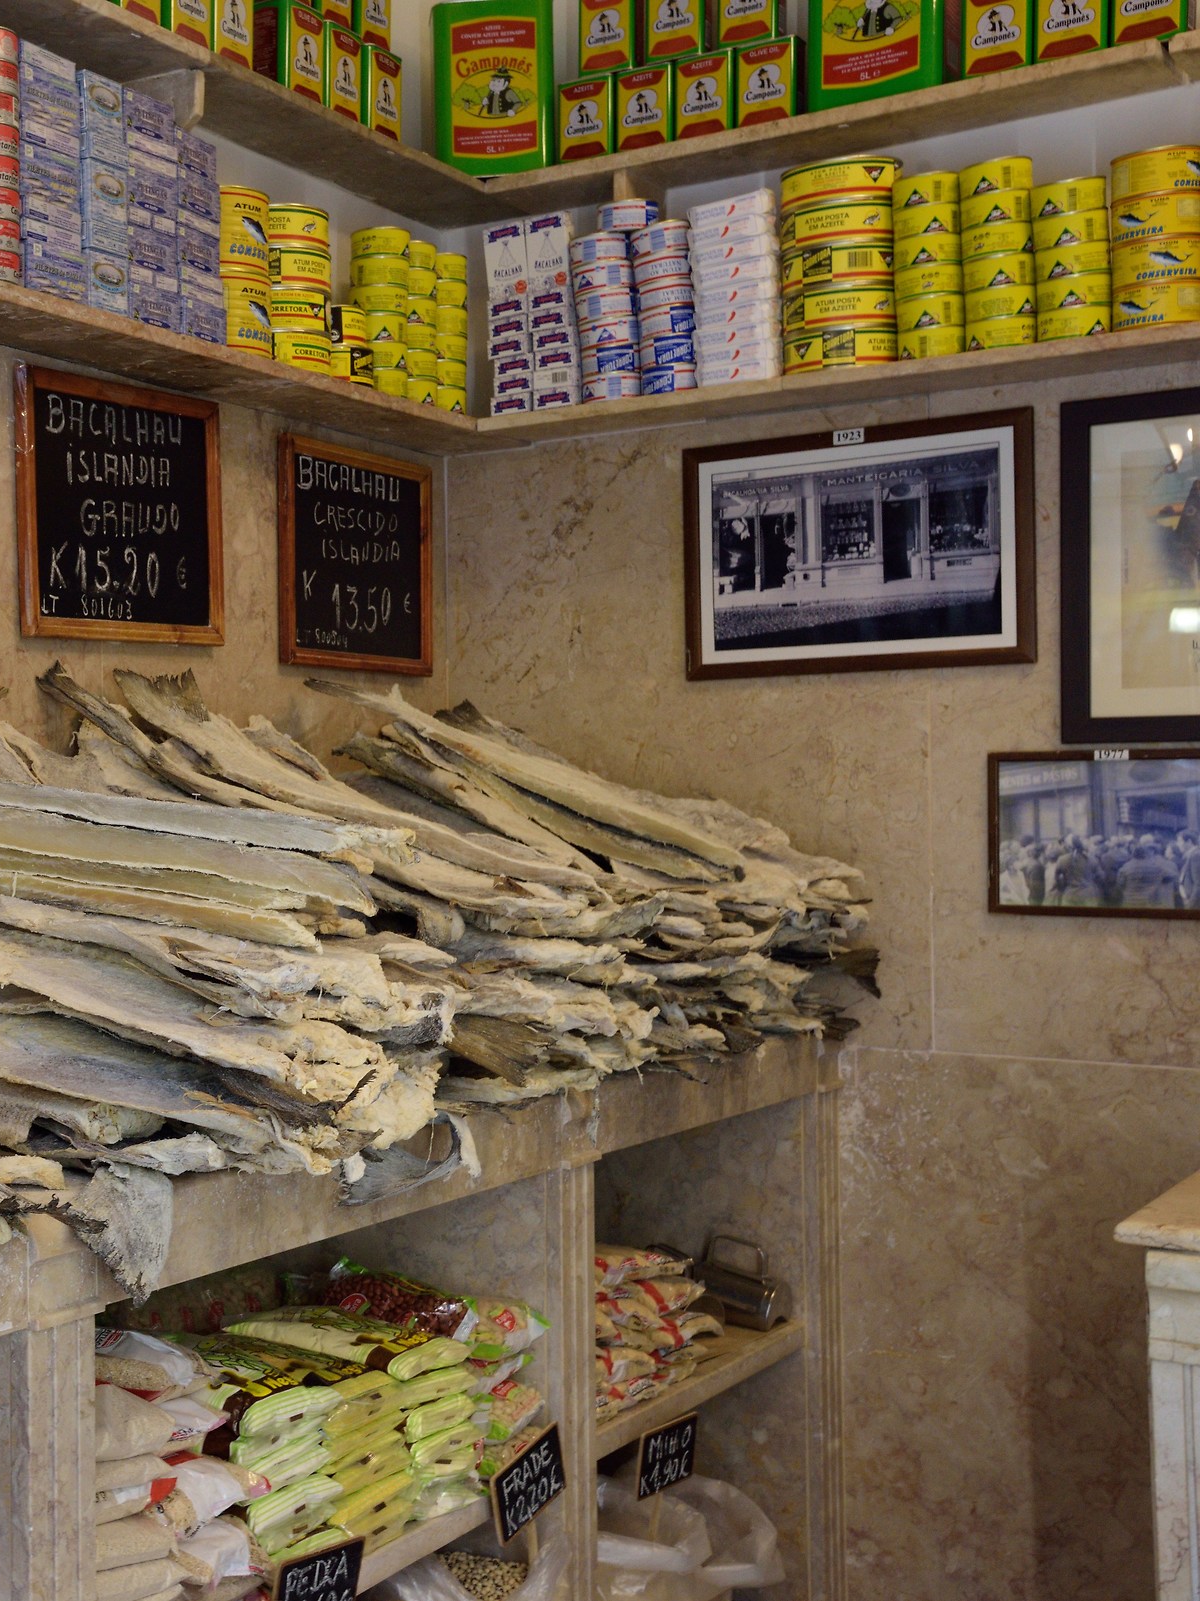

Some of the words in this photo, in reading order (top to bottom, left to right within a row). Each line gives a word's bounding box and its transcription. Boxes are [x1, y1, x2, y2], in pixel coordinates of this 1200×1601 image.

[749, 48, 768, 58] OLIVE
[768, 46, 780, 54] OIL
[691, 60, 712, 70] AZEITE
[632, 73, 653, 82] AZEITE
[859, 72, 871, 81] 5L
[573, 84, 594, 93] AZEITE
[486, 145, 496, 153] 5L
[234, 202, 261, 213] ATUM
[805, 216, 824, 225] ATUM
[825, 212, 850, 220] POSTA
[820, 220, 845, 229] AZEITE
[293, 259, 311, 267] ATUM
[311, 261, 326, 270] POSTA
[307, 267, 324, 275] AZEITE
[1136, 268, 1197, 281] CONSERVEIRA
[241, 287, 267, 297] ATUM
[815, 299, 835, 307] ATUM
[836, 296, 862, 304] POSTA
[294, 348, 329, 359] CORRETORA
[45, 393, 183, 446] BACALHAU
[836, 430, 862, 442] 1923
[66, 444, 171, 488] ISLANDIA
[296, 455, 400, 503] BACALHAU
[826, 468, 924, 487] MANTEIGARIA
[932, 460, 981, 475] SILVA
[79, 498, 180, 538] GRAUDO
[313, 500, 399, 536] CRESCIDO
[321, 538, 400, 566] ISLANDIA
[49, 541, 68, 589] K
[75, 544, 160, 599] 15.20
[176, 556, 188, 590] €
[41, 593, 60, 615] LT
[302, 569, 317, 601] K
[331, 583, 392, 634] 13.50
[403, 592, 412, 614] €
[1098, 749, 1125, 759] 1977
[503, 1441, 553, 1505] FRADE
